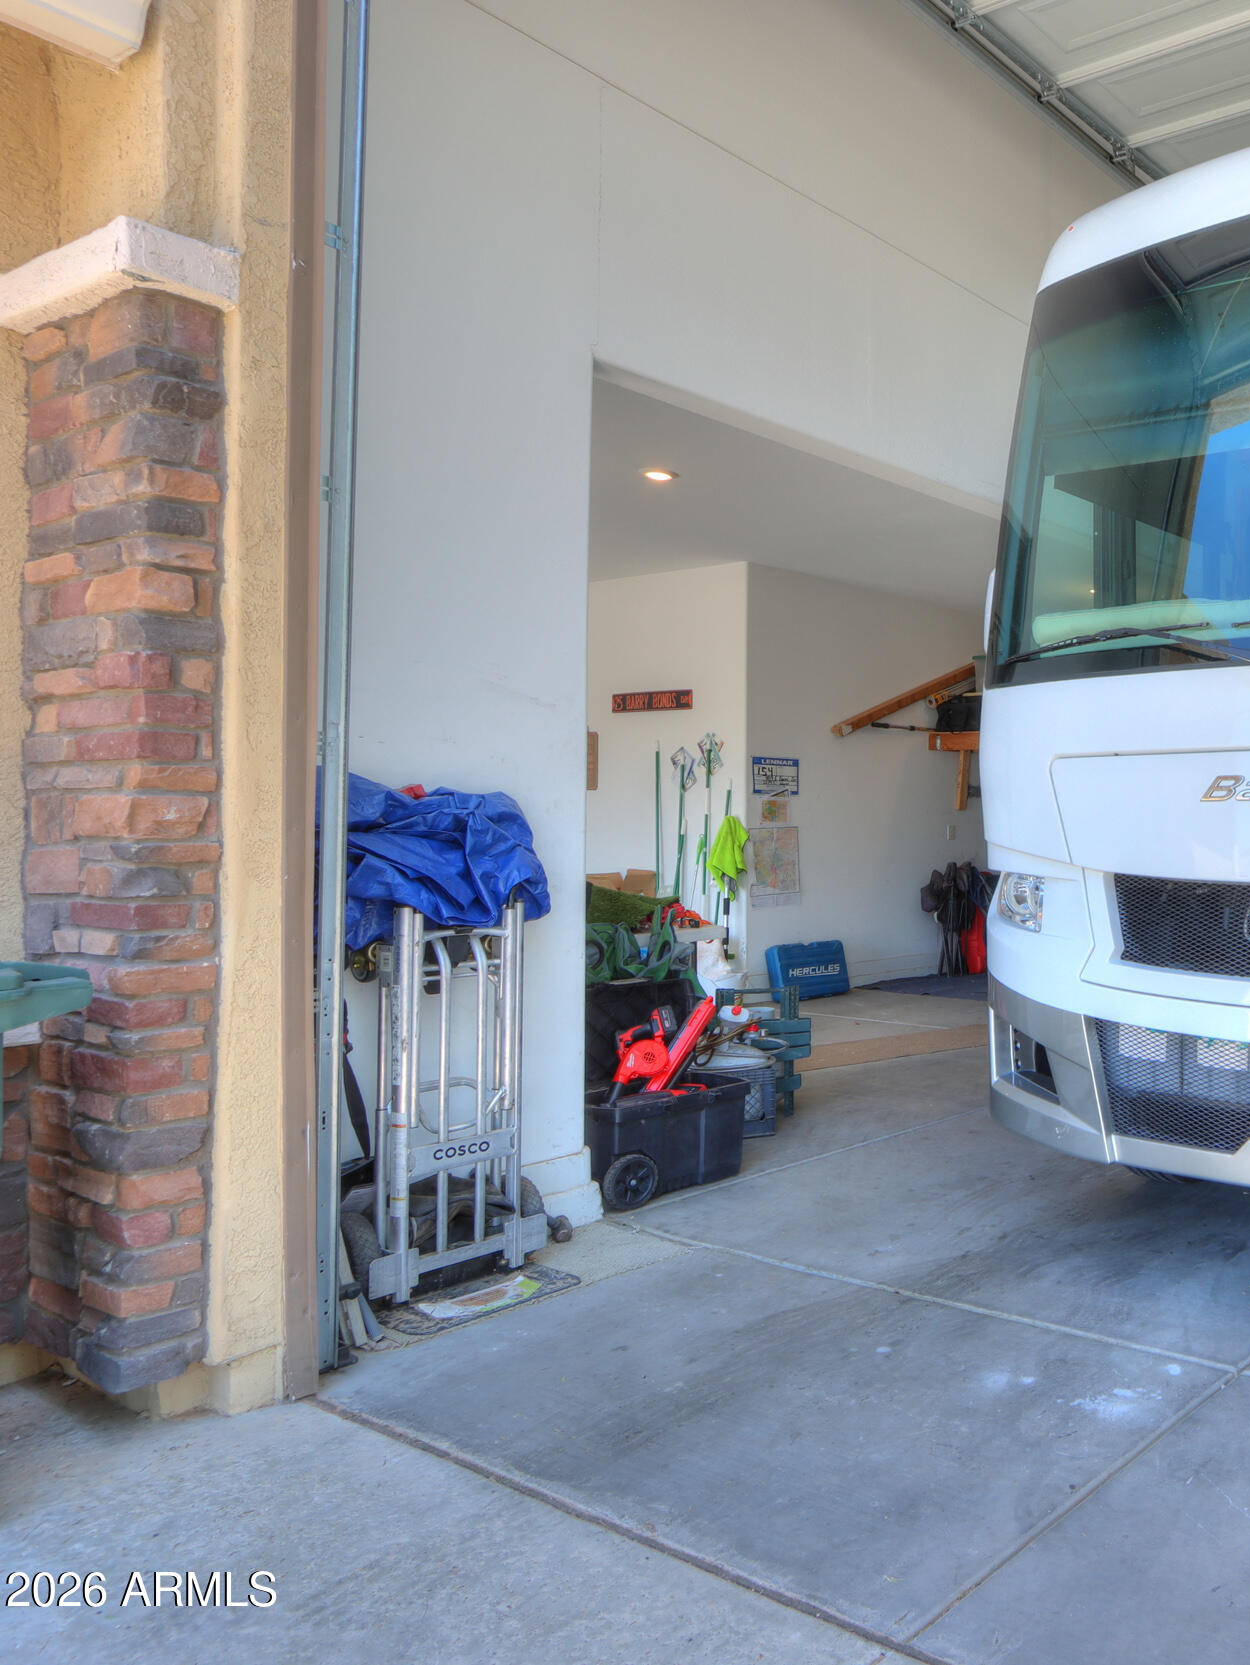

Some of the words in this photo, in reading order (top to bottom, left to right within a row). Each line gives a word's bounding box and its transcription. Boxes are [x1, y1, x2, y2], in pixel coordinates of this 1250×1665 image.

[626, 693, 649, 710] BARRY
[652, 692, 677, 708] BONDS
[789, 964, 840, 977] HERCULES
[433, 1141, 490, 1160] COSCO
